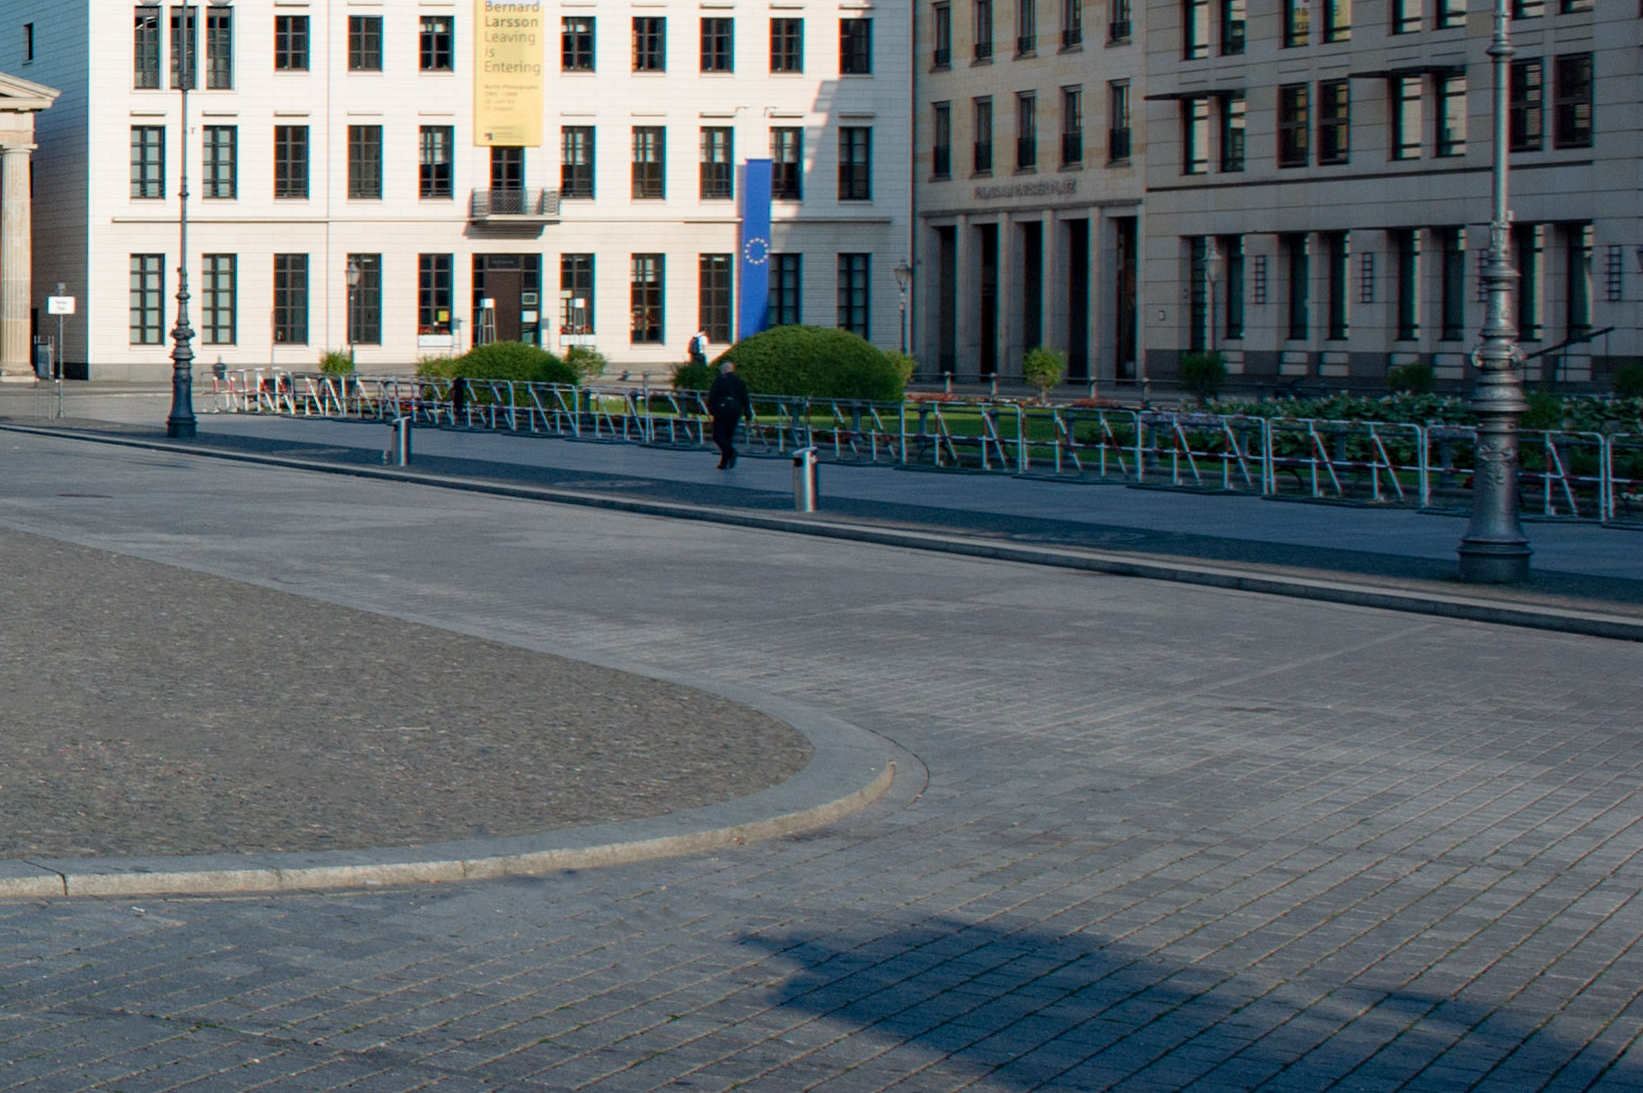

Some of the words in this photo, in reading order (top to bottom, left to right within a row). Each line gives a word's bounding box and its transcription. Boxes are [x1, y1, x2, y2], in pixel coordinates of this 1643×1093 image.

[484, 0, 540, 12] Bernard
[484, 16, 539, 27] Larsson
[484, 31, 536, 46] Leaving
[485, 45, 495, 58] is
[484, 60, 541, 76] Entering
